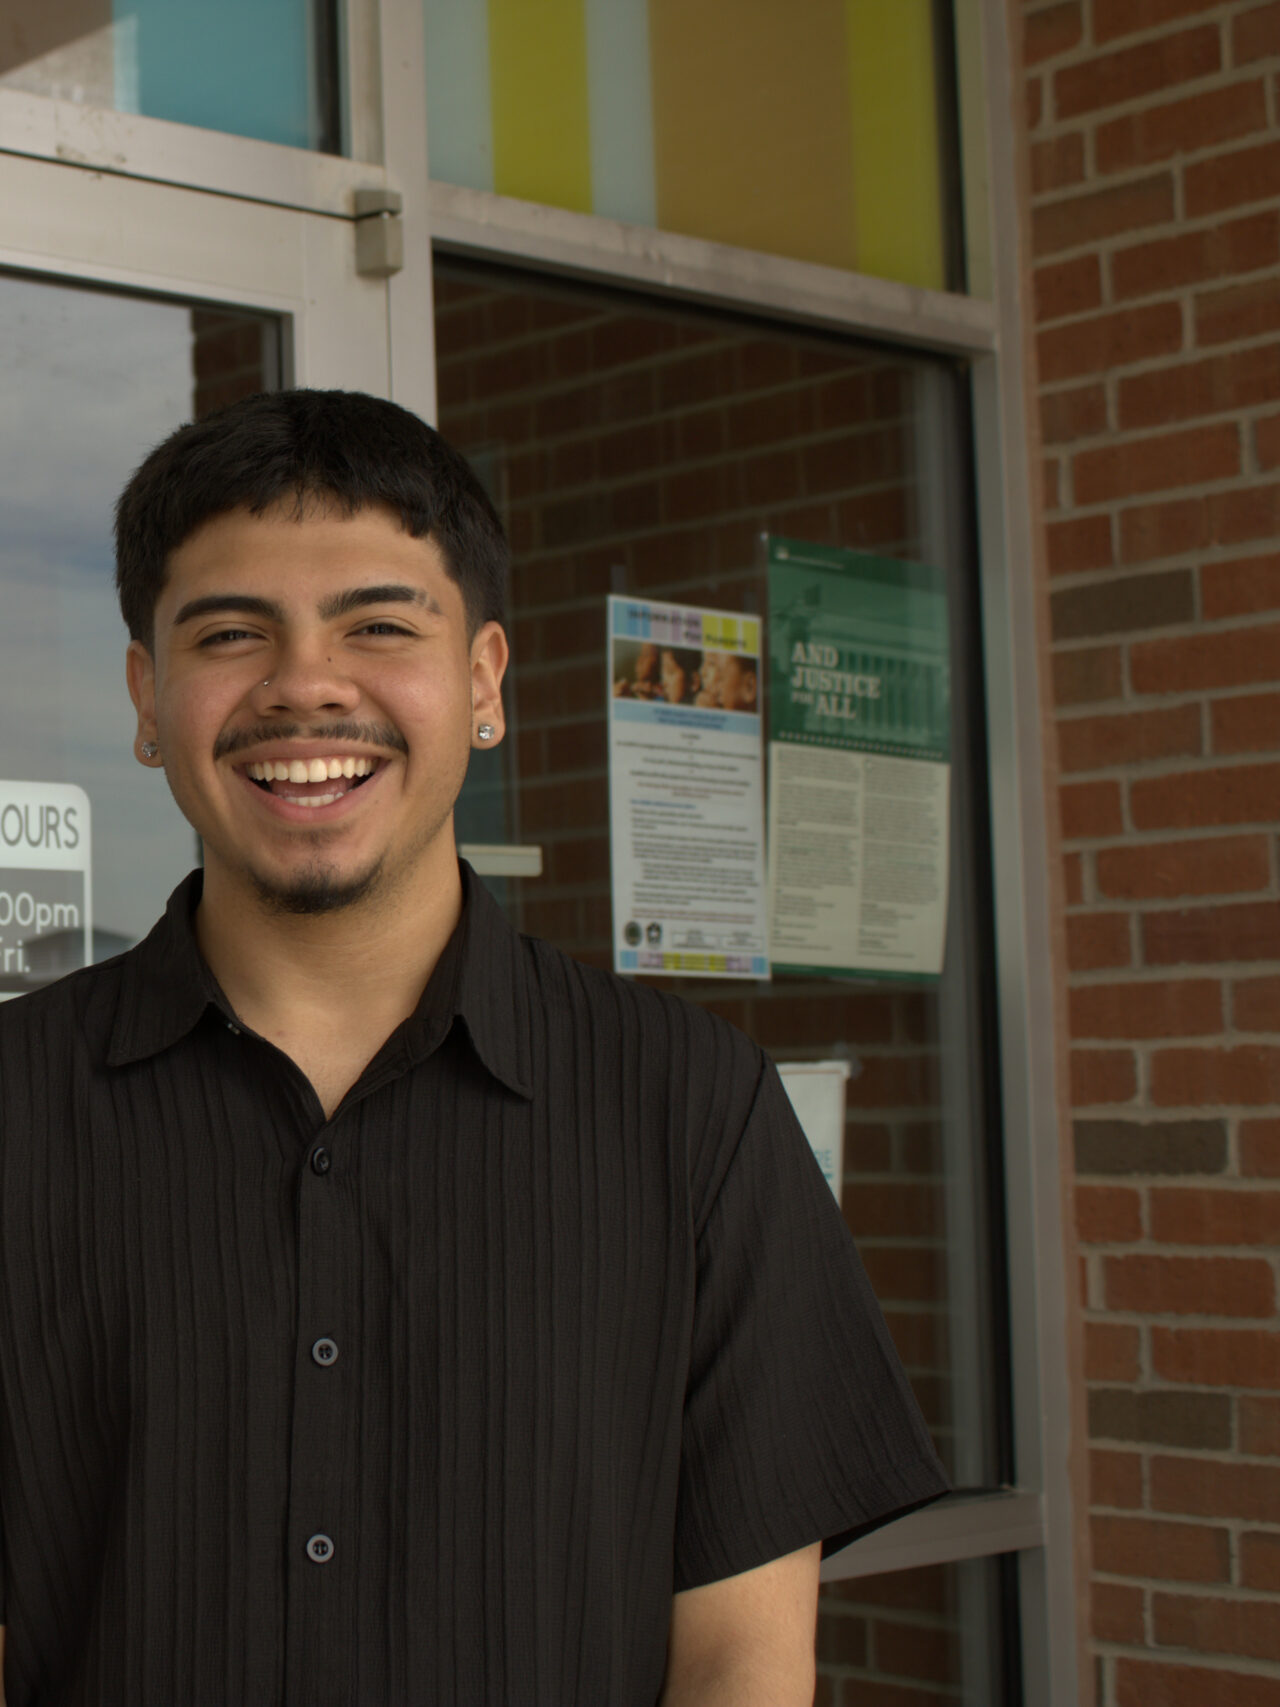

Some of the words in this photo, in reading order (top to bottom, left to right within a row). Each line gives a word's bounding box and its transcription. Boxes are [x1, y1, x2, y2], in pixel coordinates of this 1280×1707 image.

[791, 641, 839, 668] AND
[791, 666, 881, 699] JUSTICE
[816, 694, 857, 719] ALL
